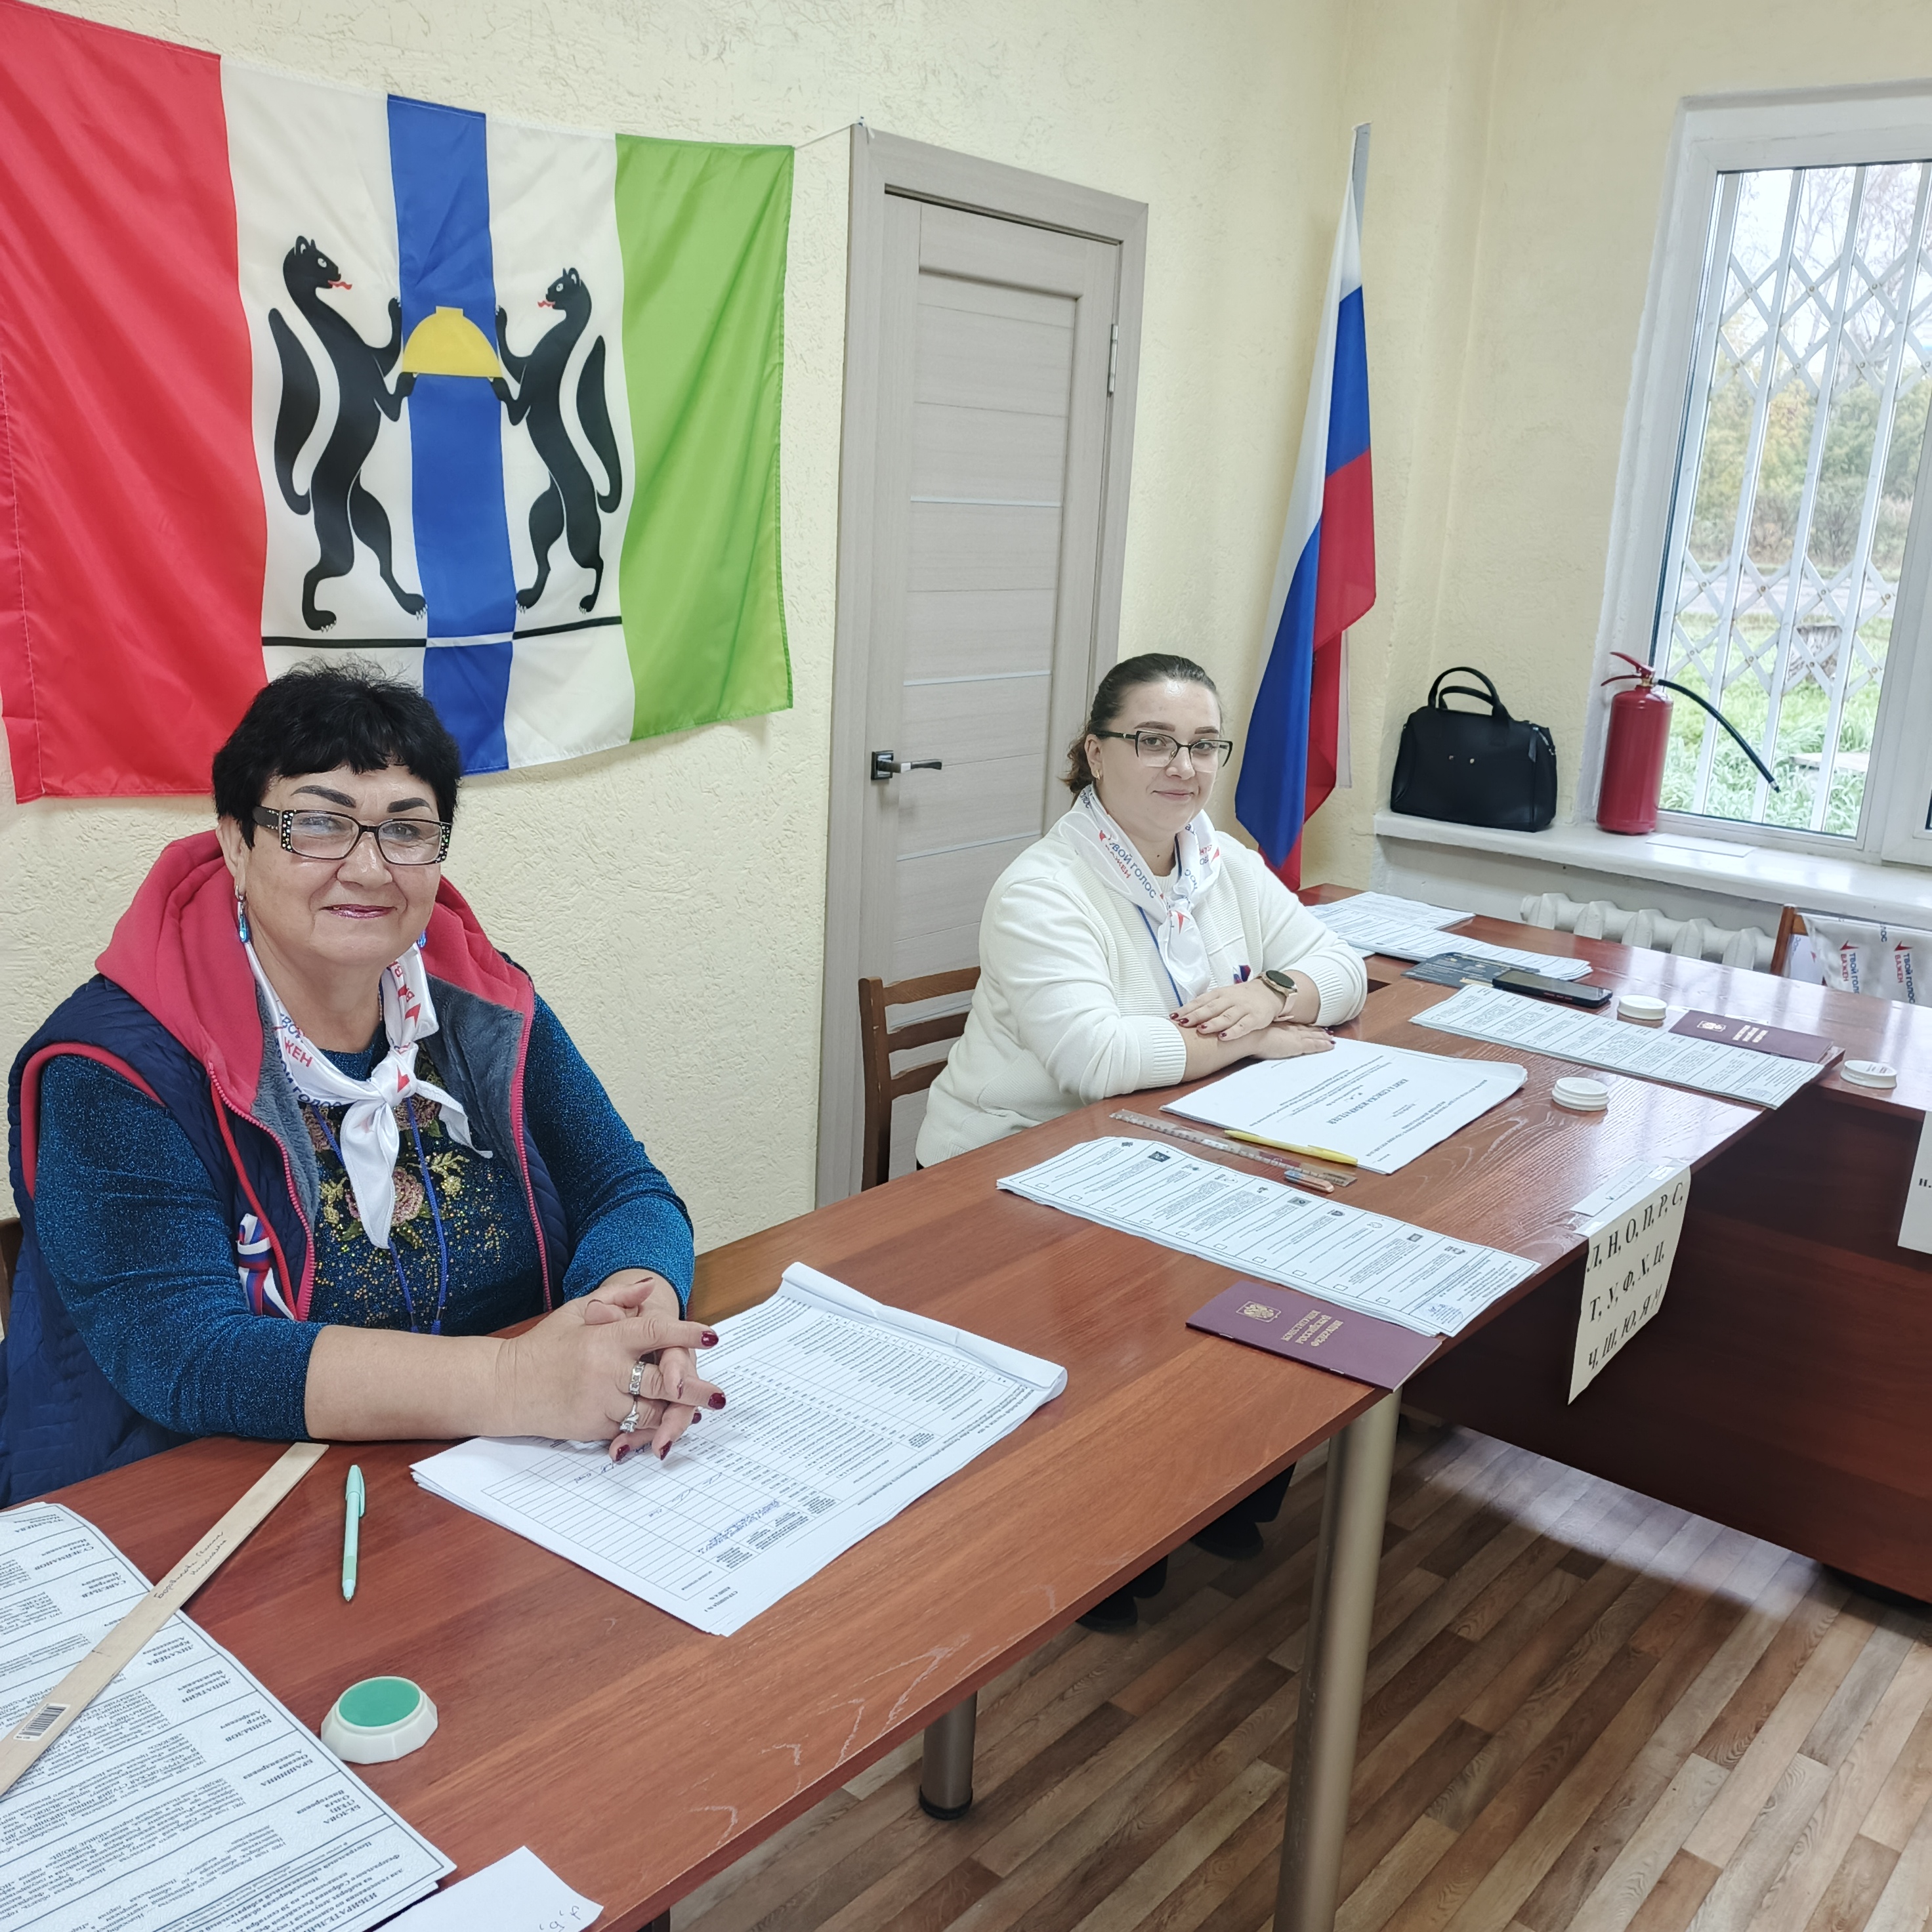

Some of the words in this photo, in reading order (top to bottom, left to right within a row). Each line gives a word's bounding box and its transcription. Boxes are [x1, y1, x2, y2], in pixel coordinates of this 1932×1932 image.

[1108, 835, 1133, 864] ВОЙ
[1130, 862, 1156, 898] ГОЛОС
[1849, 953, 1859, 975] ТВОЙ
[1895, 954, 1904, 983] ВАЖЕН
[1903, 953, 1913, 975] ТВОЙ
[1906, 976, 1916, 1003] ГОЛОС
[284, 1036, 313, 1068] ЖЕН
[1587, 1243, 1602, 1272] Л,
[1607, 1230, 1621, 1259] Н,
[1626, 1219, 1638, 1243] О,
[1642, 1204, 1654, 1231] П,
[1658, 1194, 1668, 1219] Р,
[1672, 1183, 1683, 1206] С,
[1589, 1296, 1602, 1322] Т,
[1607, 1282, 1618, 1309] У,
[1623, 1270, 1635, 1292] Ф,
[34, 1546, 94, 1570] СУЛЕЙМАНОВ
[81, 1580, 127, 1598] САВЕЛЬЕВ
[142, 1636, 185, 1655] Алексеевна
[146, 1644, 194, 1666] ЛИХАЧЁВА
[153, 1640, 190, 1656] Кристина
[177, 1670, 223, 1691] Васильевич
[182, 1678, 231, 1703] ЛИПАТКИН
[186, 1674, 226, 1694] Александр
[220, 1708, 261, 1729] Андреевич
[246, 1713, 267, 1725] Петр
[225, 1719, 272, 1742] КОПЫЛОВ
[243, 1749, 302, 1780] Александровна
[278, 1754, 308, 1770] Оксана
[296, 1789, 345, 1815] Викторовна
[324, 1795, 350, 1808] Ольга
[323, 1804, 361, 1824] БЕЛОВА
[287, 1906, 335, 1932] одномандат
[303, 1892, 377, 1932] ИЗБИРАТЕЛЬН
[271, 1920, 294, 1932] Госу
